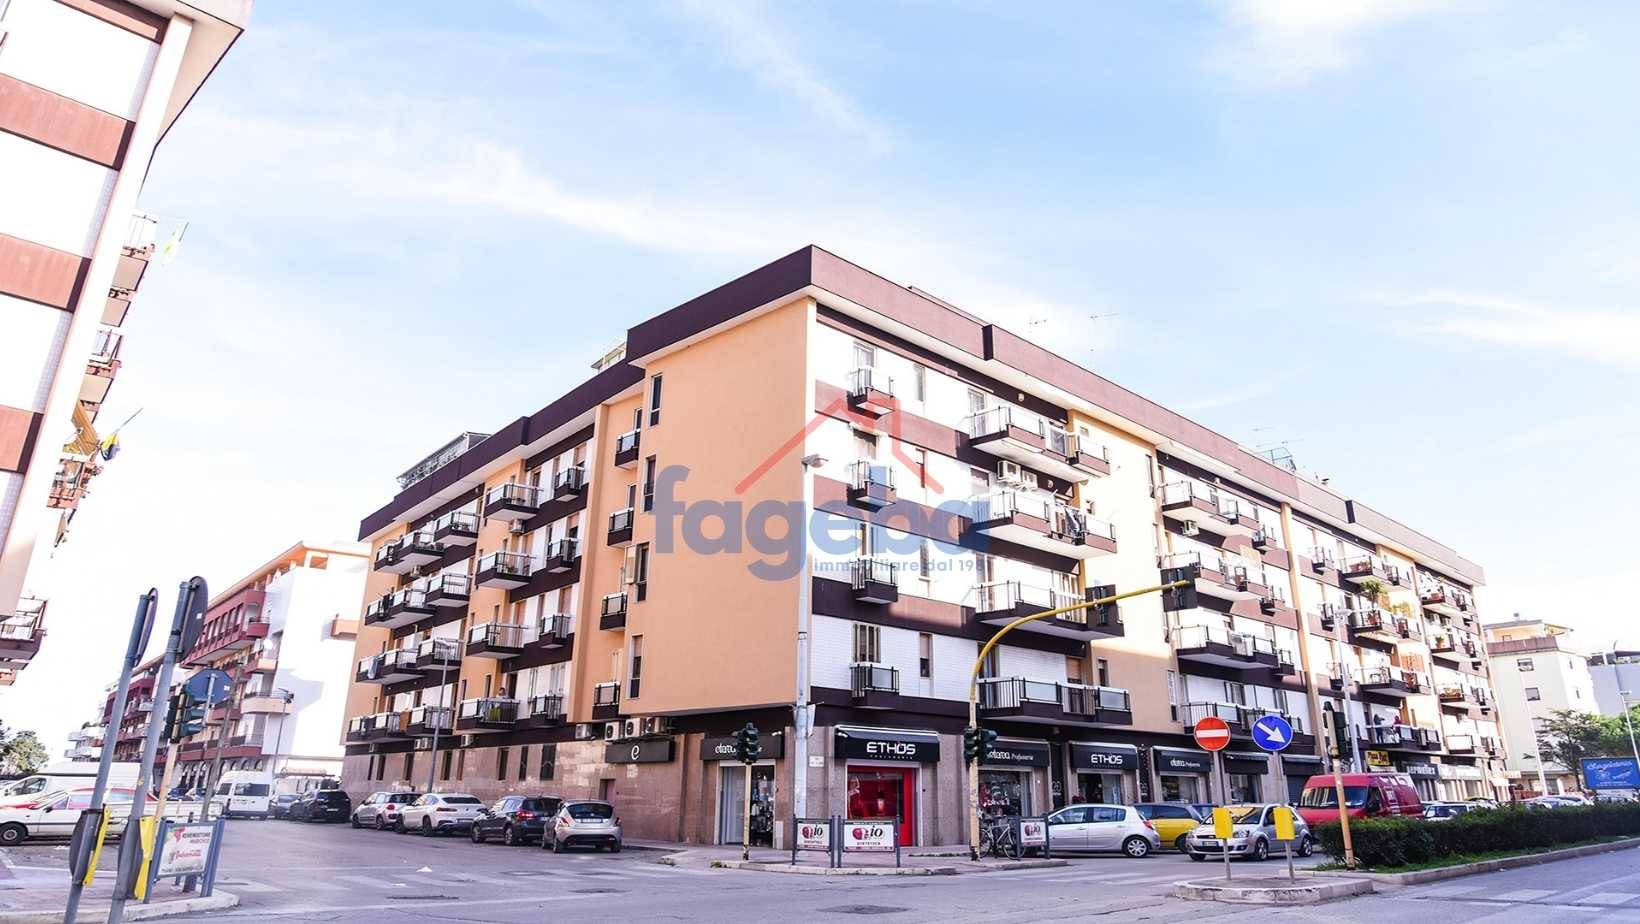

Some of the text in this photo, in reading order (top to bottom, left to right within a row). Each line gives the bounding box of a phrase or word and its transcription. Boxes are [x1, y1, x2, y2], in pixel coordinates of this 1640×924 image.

[631, 745, 640, 760] e
[866, 741, 916, 755] ETHOS
[1090, 753, 1123, 765] ETHOS
